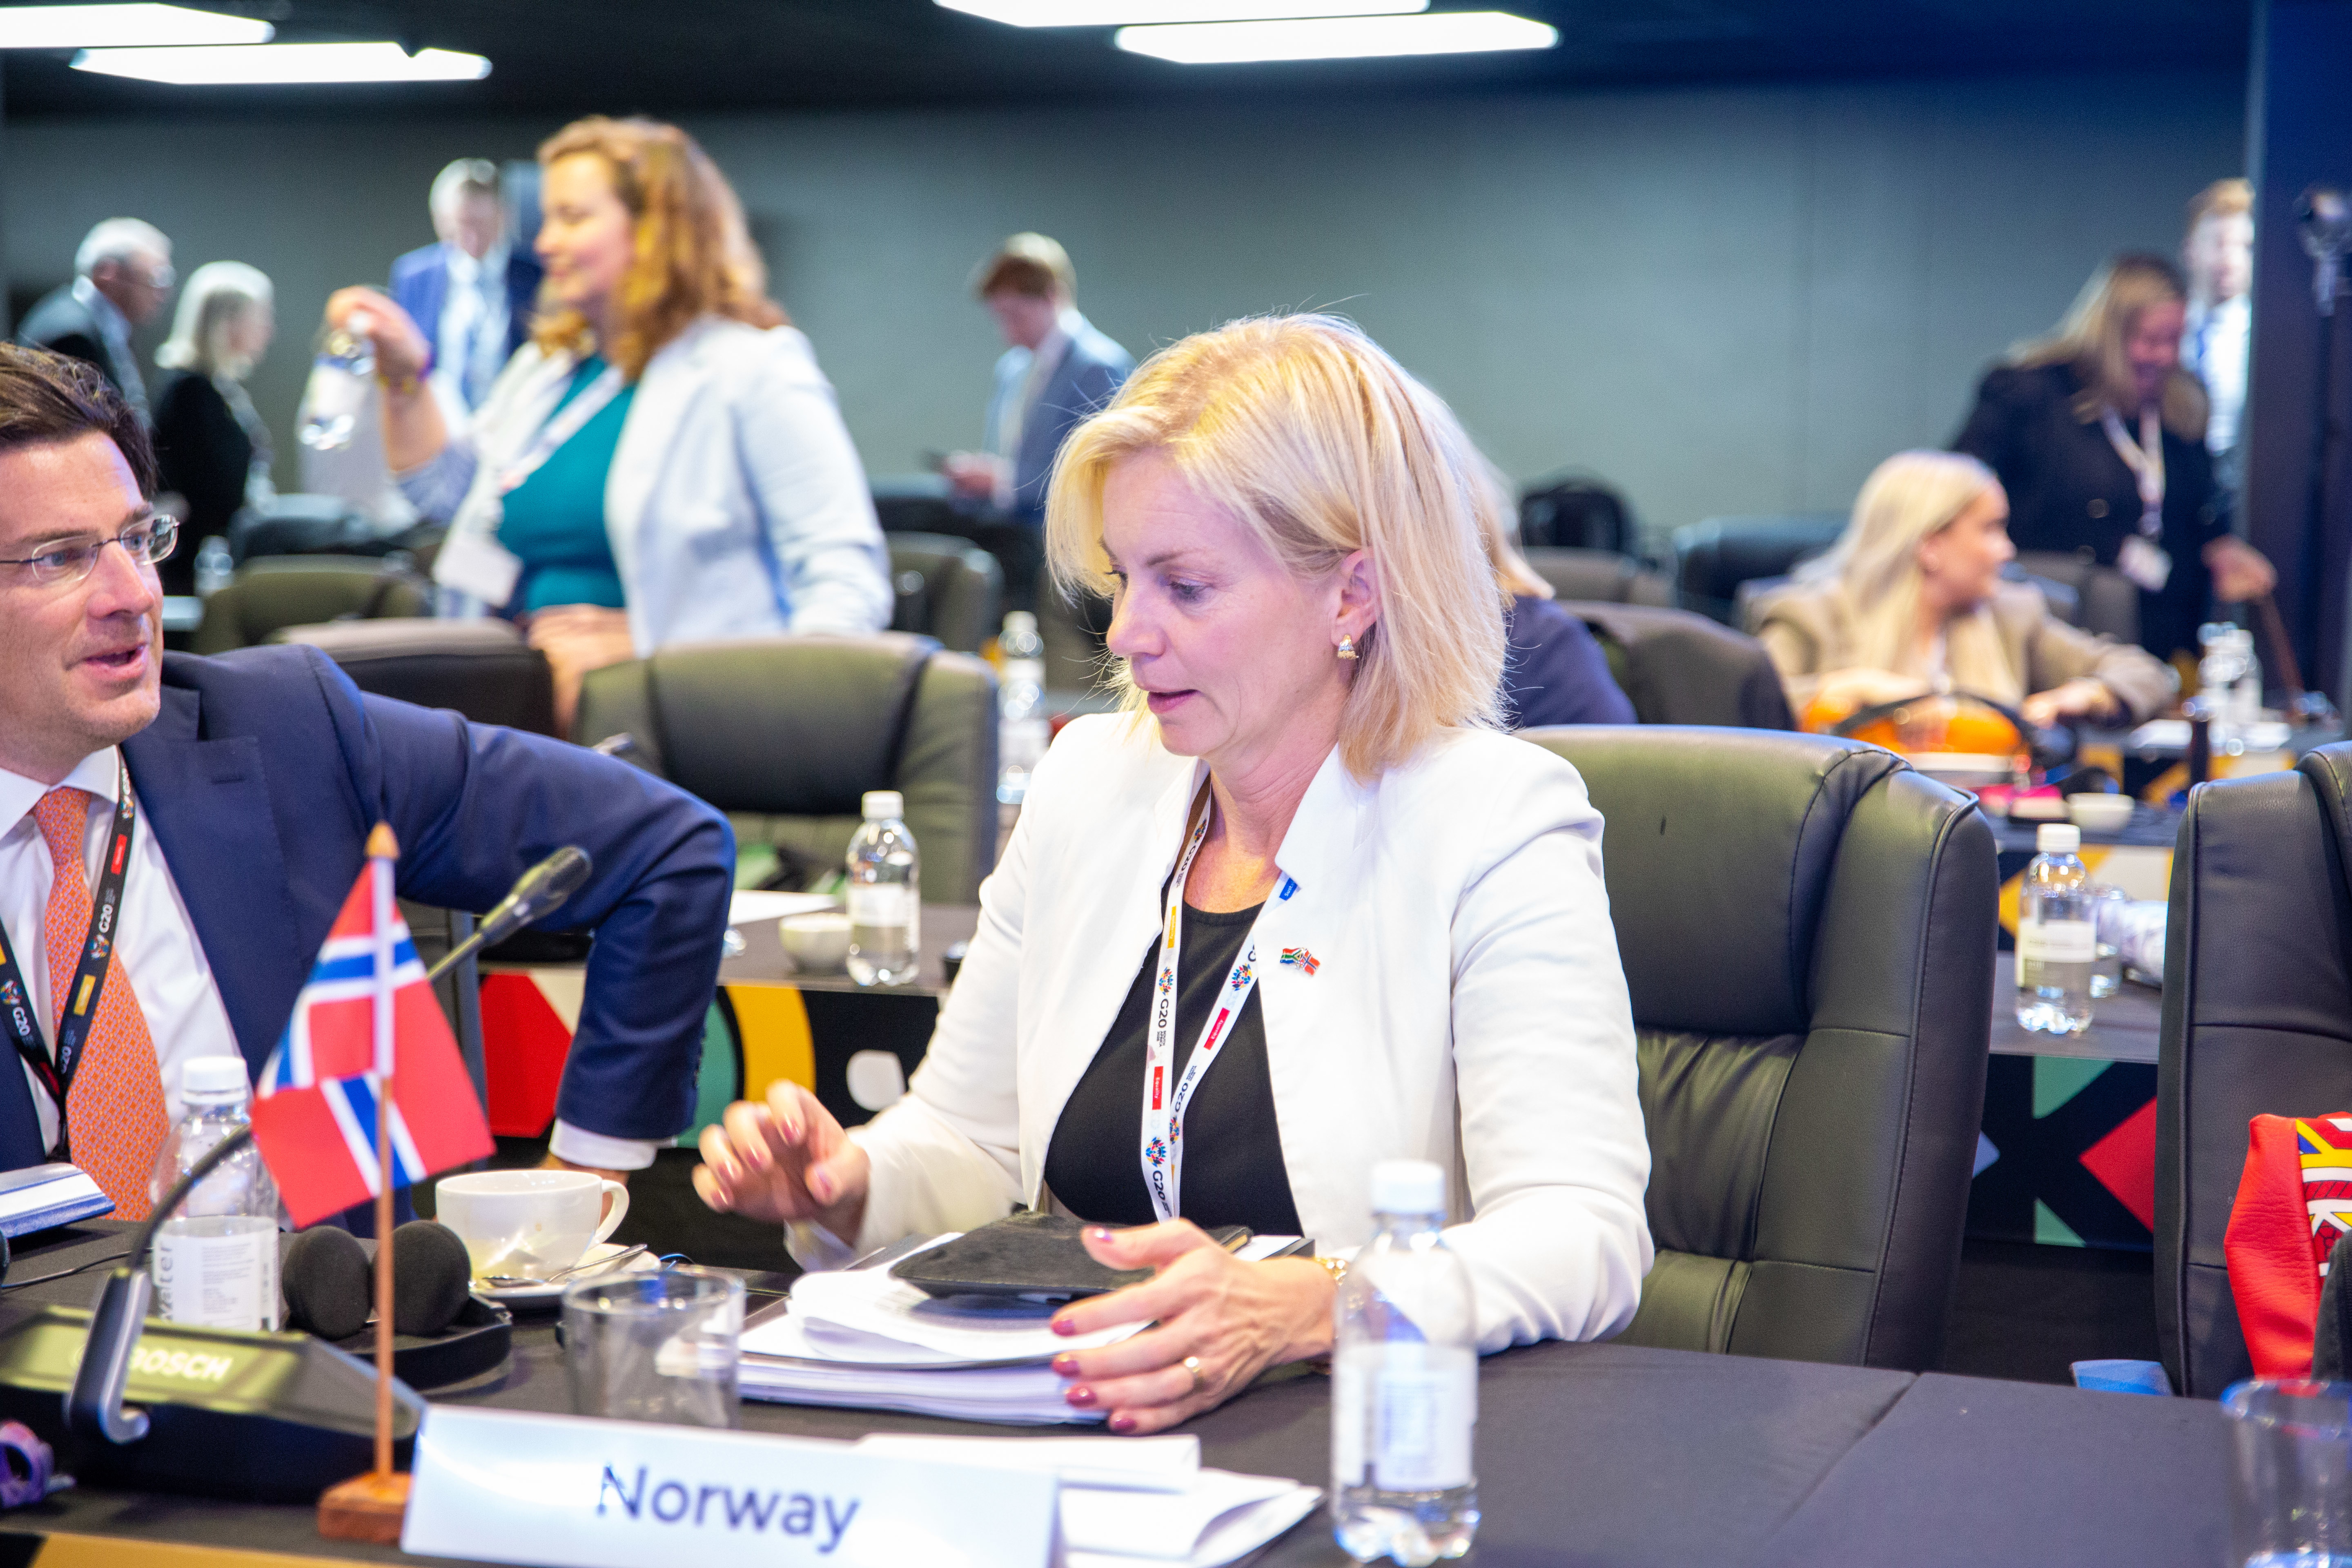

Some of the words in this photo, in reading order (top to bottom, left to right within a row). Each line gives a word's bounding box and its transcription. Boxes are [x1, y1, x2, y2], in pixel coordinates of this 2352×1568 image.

[1181, 845, 1196, 871] G20
[98, 904, 113, 933] G20
[12, 1007, 30, 1036] G20
[1158, 998, 1169, 1028] G20
[1211, 1019, 1223, 1040] Equality
[1175, 1082, 1188, 1112] G20
[1153, 1170, 1165, 1200] G20
[597, 1463, 860, 1555] Norway
